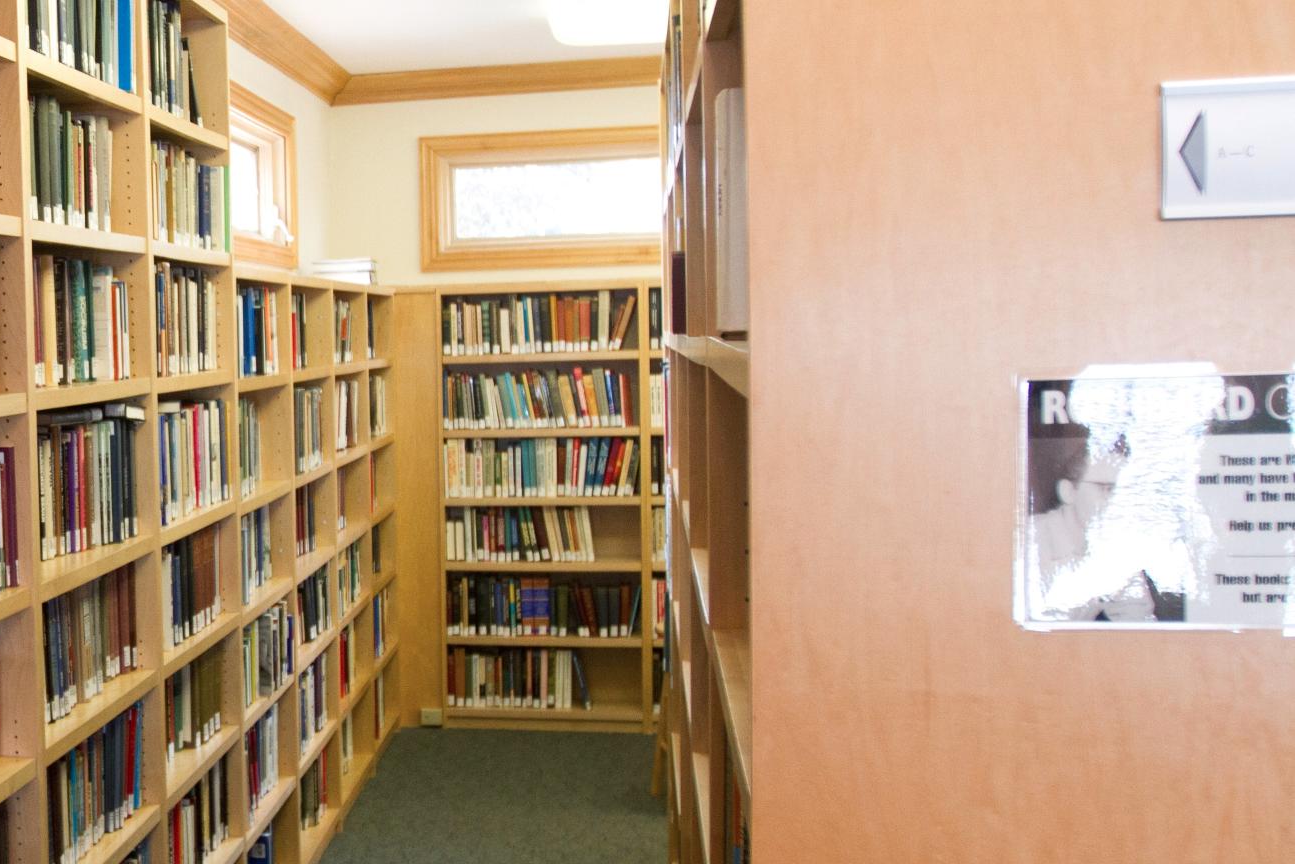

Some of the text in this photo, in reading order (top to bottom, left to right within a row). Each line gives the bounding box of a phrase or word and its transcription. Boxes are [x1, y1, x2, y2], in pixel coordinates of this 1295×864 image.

[1220, 454, 1255, 466] These
[1260, 457, 1281, 466] are
[1199, 474, 1289, 486] and many have
[1245, 491, 1280, 502] in the
[1229, 520, 1254, 533] Help
[1258, 522, 1272, 532] us
[1215, 574, 1250, 584] These
[1243, 592, 1261, 602] but
